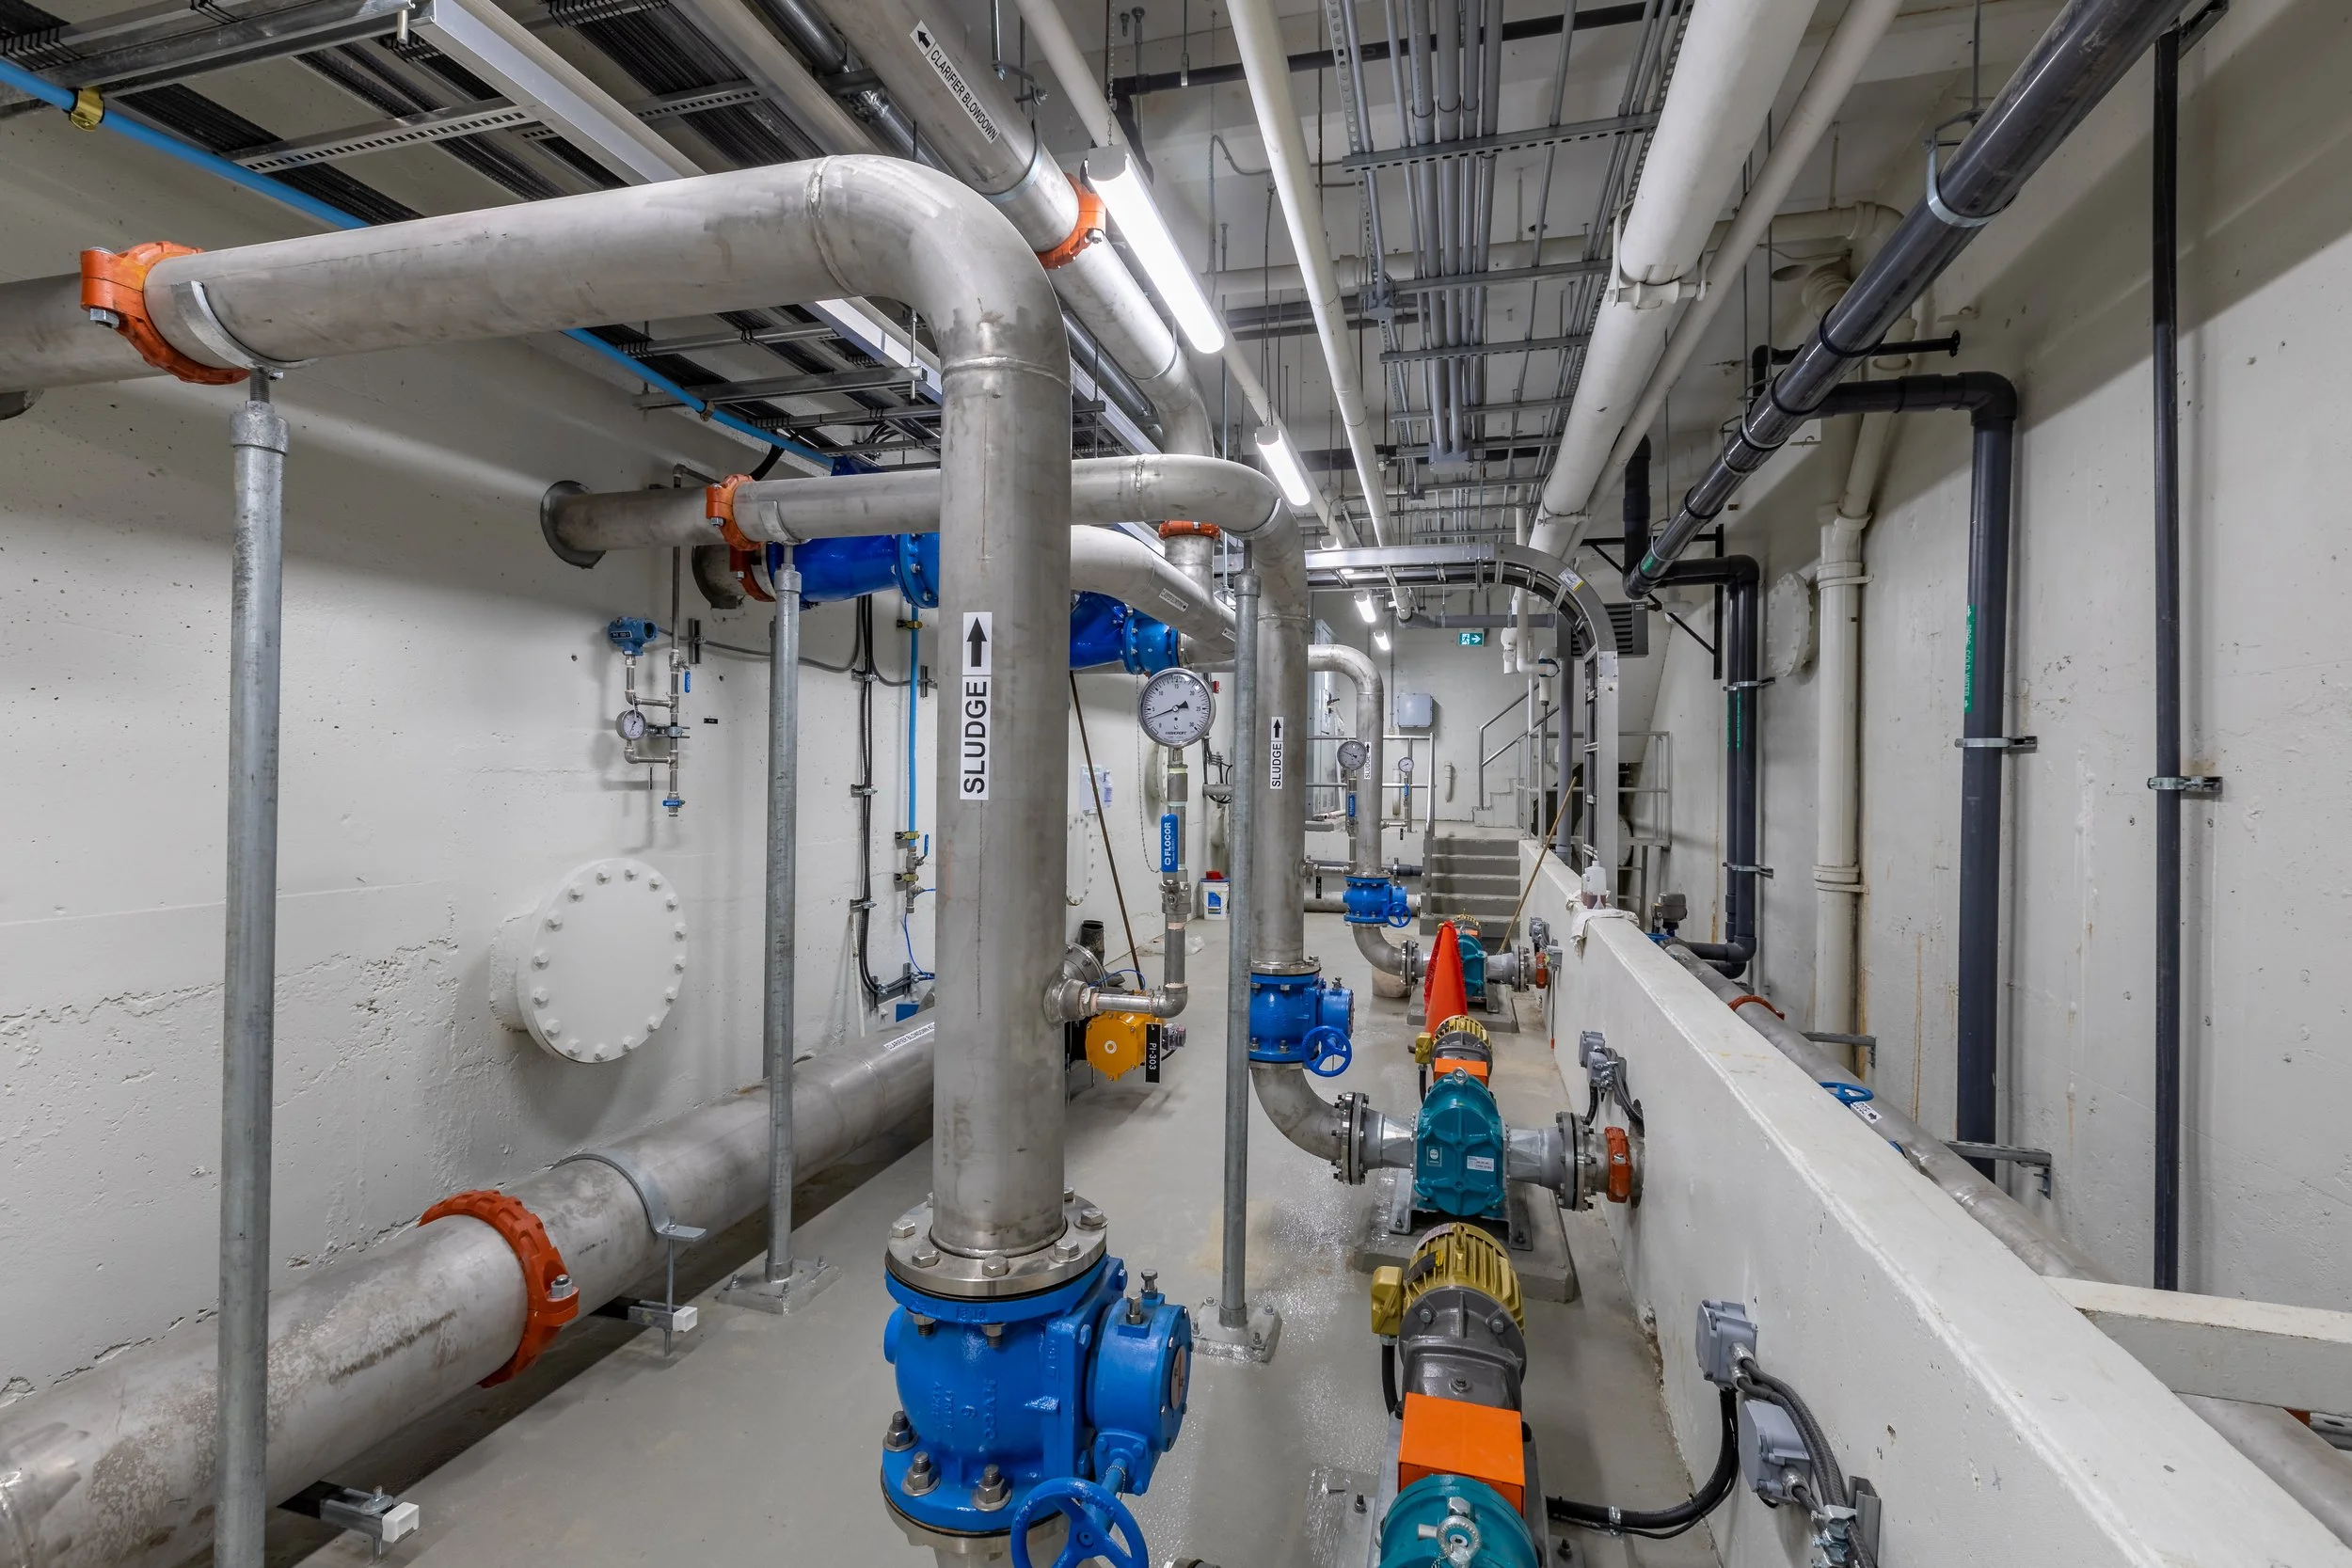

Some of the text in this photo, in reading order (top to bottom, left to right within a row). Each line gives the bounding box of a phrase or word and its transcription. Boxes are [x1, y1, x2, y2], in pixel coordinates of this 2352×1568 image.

[930, 50, 998, 140] CLARIFIER BLOWDOWN
[963, 681, 988, 794] SLUDGE
[1272, 743, 1282, 787] SLUDGE
[1149, 1042, 1157, 1070] PI-303
